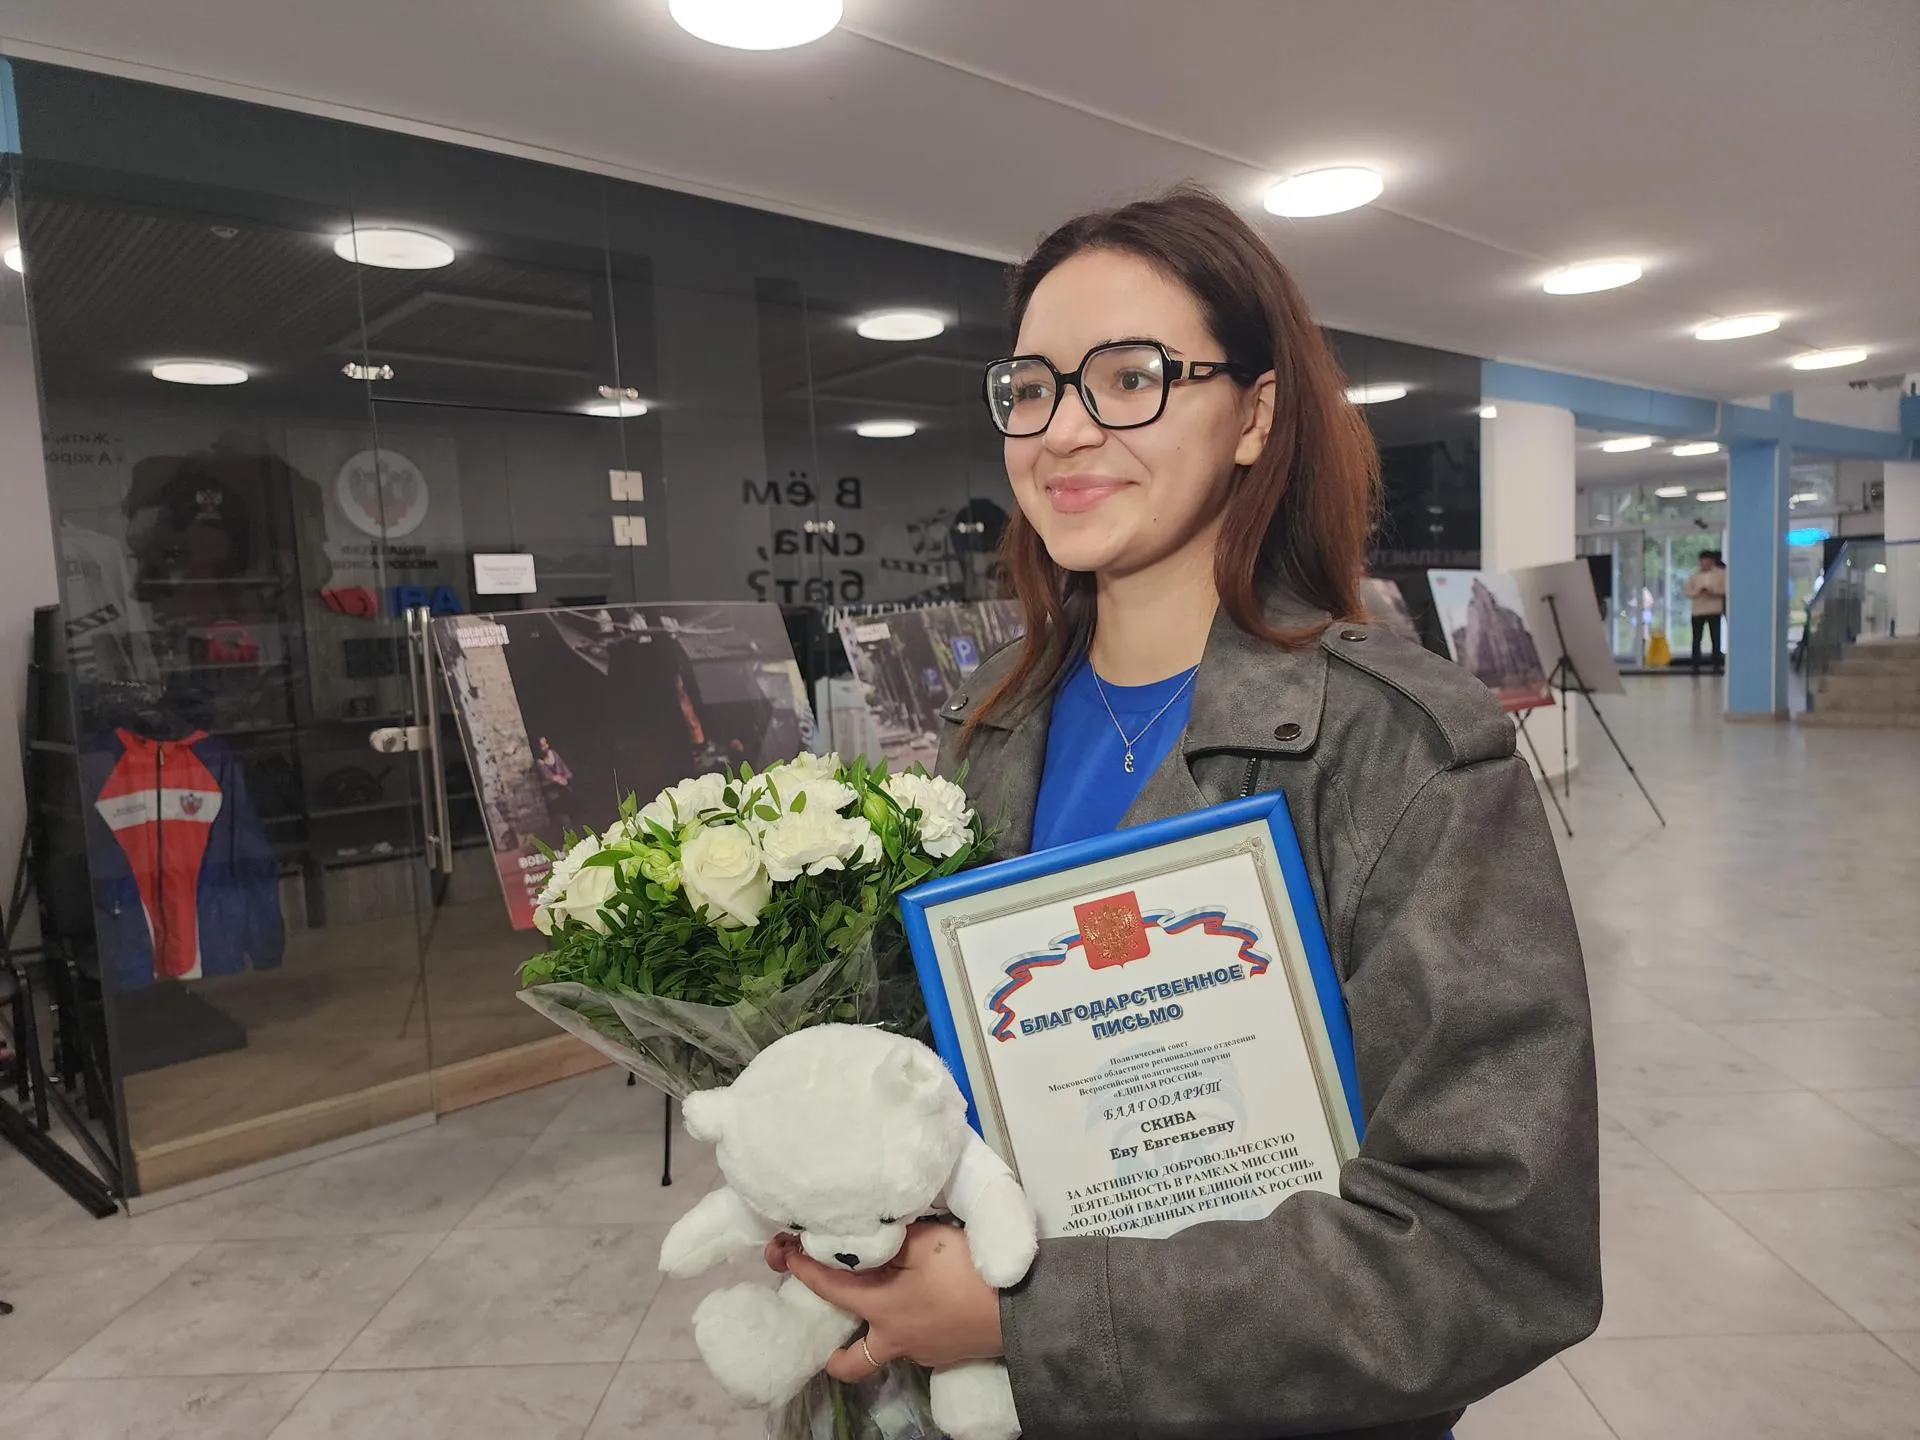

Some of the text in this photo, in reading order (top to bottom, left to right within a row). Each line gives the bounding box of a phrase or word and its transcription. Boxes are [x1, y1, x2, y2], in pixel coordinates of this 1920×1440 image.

[1019, 963, 1244, 1036] БЛАГОДАРСТВЕННОЕ
[1091, 1003, 1184, 1040] ПИСЬМО
[1048, 1034, 1256, 1093] Московского областного регионального отделения
[1079, 1051, 1232, 1096] Всероссийской политической партии
[1110, 1040, 1189, 1066] Политический совет
[1103, 1079, 1222, 1121] БЛАГОДАРИТ
[1113, 1069, 1203, 1099] «ЕДИНАЯ РОССИЯ»
[1109, 1120, 1236, 1161] Еву Евгеньевну
[1140, 1110, 1197, 1134] СКИБА
[1064, 1132, 1296, 1201] ЗА АКТИВНУЮ ДОБРОВОЛЬЧЕСКУЮ
[1070, 1146, 1300, 1216] ДЕЯТЕЛЬНОСТЬ В РАМКАХ МИССИИ
[1062, 1158, 1315, 1233] «МОЛОДОЙ ГВАРДИИ ЕДИНОЙ РОССИИ»
[1075, 1204, 1196, 1237] ВОБОЖДЕННЫХ
[1197, 1185, 1268, 1212] РЕГИОНАХ
[1269, 1169, 1324, 1193] РОССИИ
